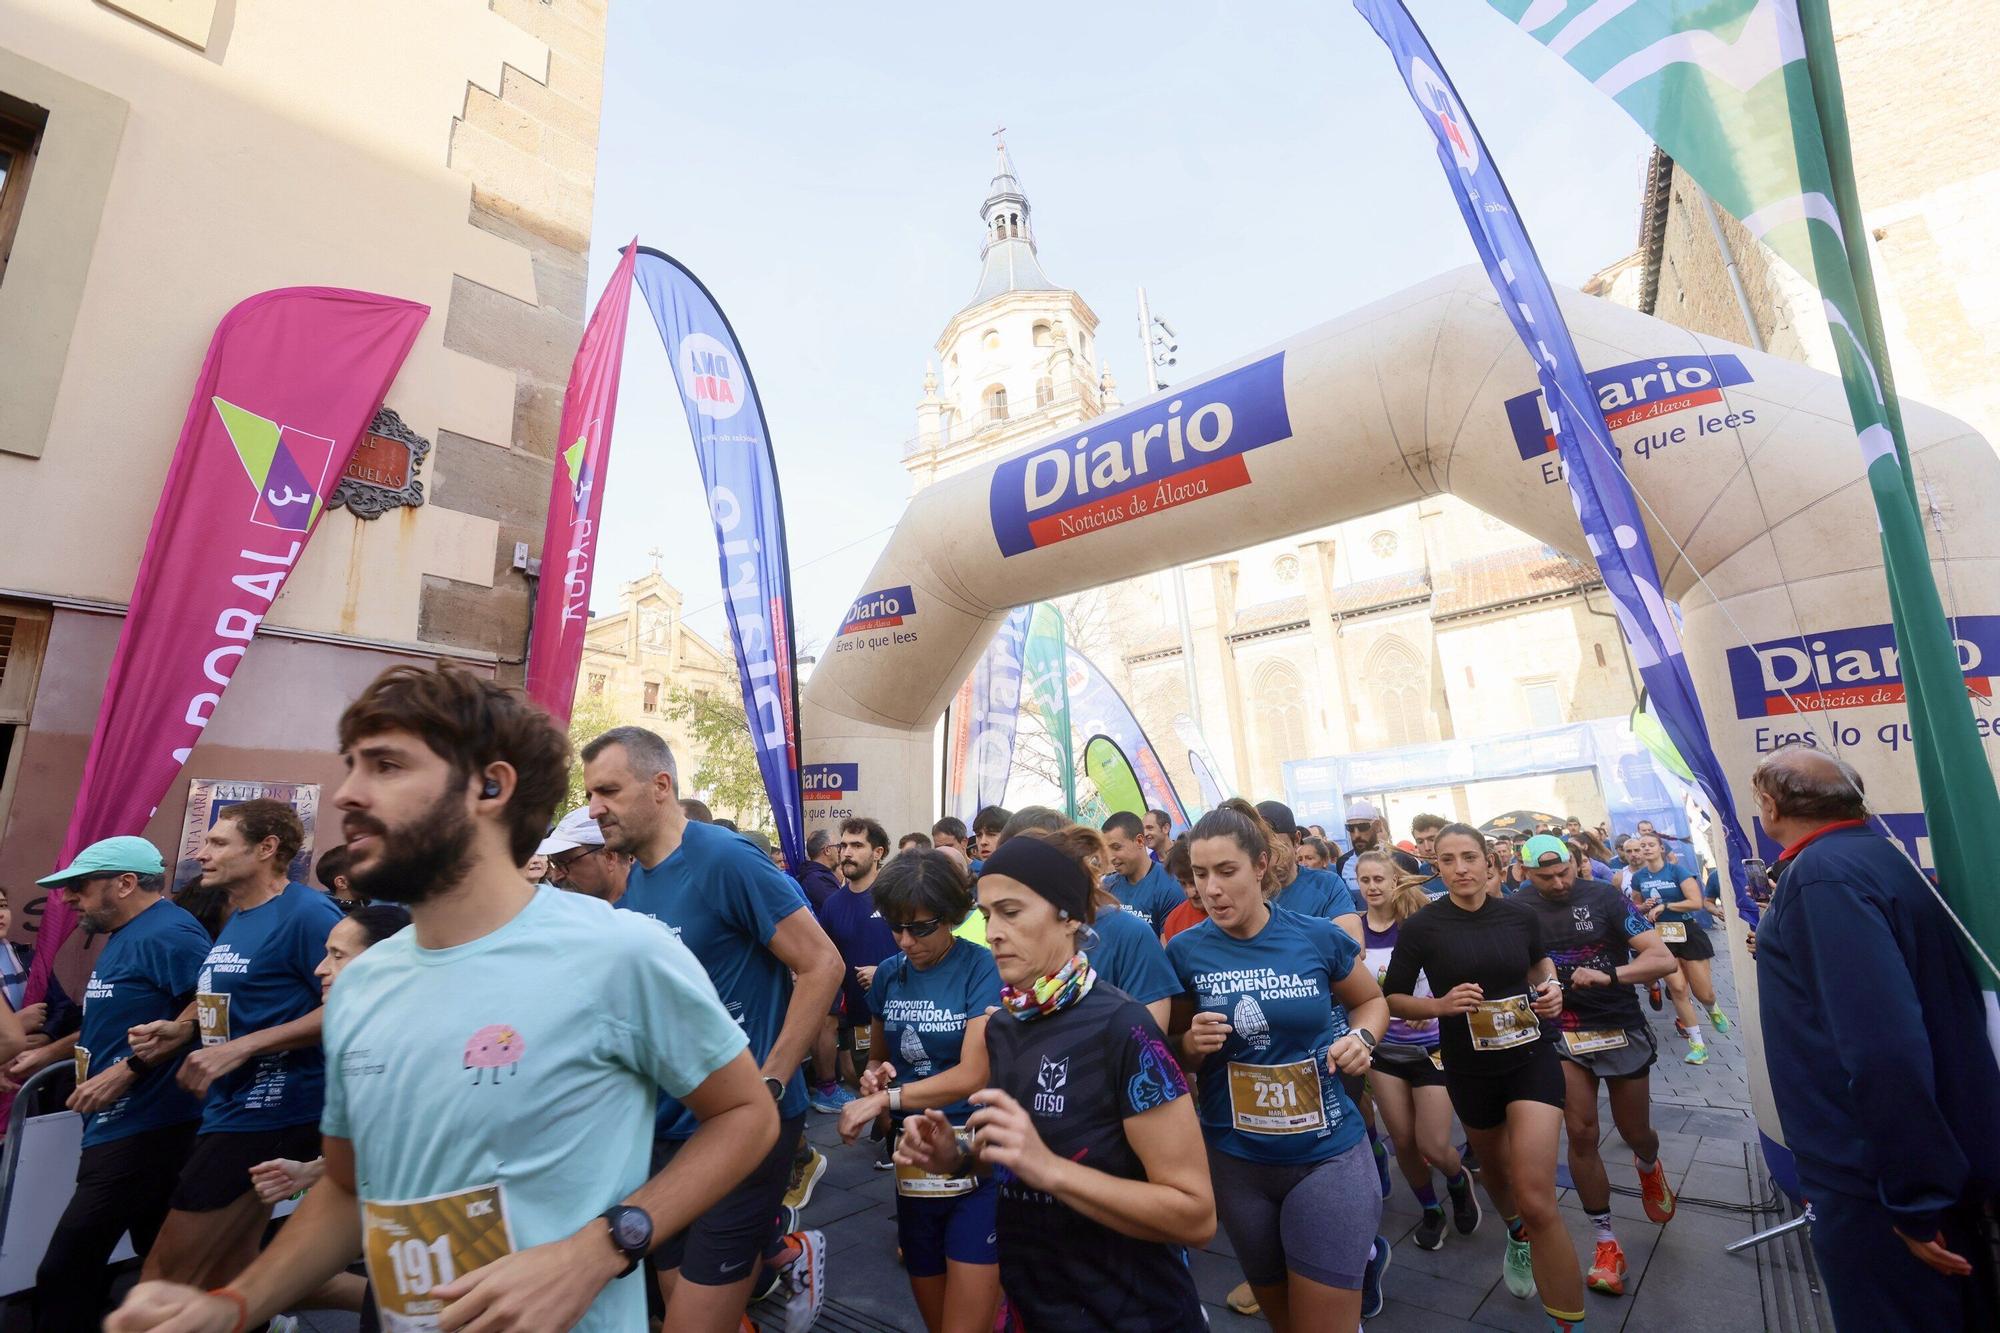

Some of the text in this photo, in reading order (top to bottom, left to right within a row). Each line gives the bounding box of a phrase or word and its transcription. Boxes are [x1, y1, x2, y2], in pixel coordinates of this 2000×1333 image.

[1627, 410, 1642, 423] de
[1646, 399, 1692, 418] Álava
[1633, 427, 1686, 459] que
[1698, 408, 1756, 436] lees
[1024, 400, 1233, 513] Diario
[345, 463, 402, 487] CUELAS
[1541, 461, 1563, 485] Er
[1059, 478, 1210, 537] Noticias de Álava
[845, 594, 900, 624] Diario
[836, 631, 918, 652] Eres lo que lees
[1758, 640, 1982, 692] Diaro
[1793, 694, 1865, 712] Noticias
[1871, 688, 1892, 704] de
[1833, 720, 1861, 746] lo
[802, 767, 843, 789] iario
[809, 808, 826, 821] que
[829, 806, 852, 818] lees
[1575, 921, 1594, 931] OTSO
[1194, 968, 1276, 985] LA CONQUISTA
[1211, 974, 1304, 996] ALMENDRA
[1303, 978, 1317, 986] REN
[889, 1000, 935, 1010] CONQUISTA
[1261, 986, 1320, 1001] KONKISTA
[886, 1008, 954, 1021] ALMENDRA
[1301, 1066, 1313, 1076] 10K
[1034, 1093, 1065, 1113] OTSO
[1254, 1081, 1297, 1108] 231
[387, 1233, 457, 1296] 191
